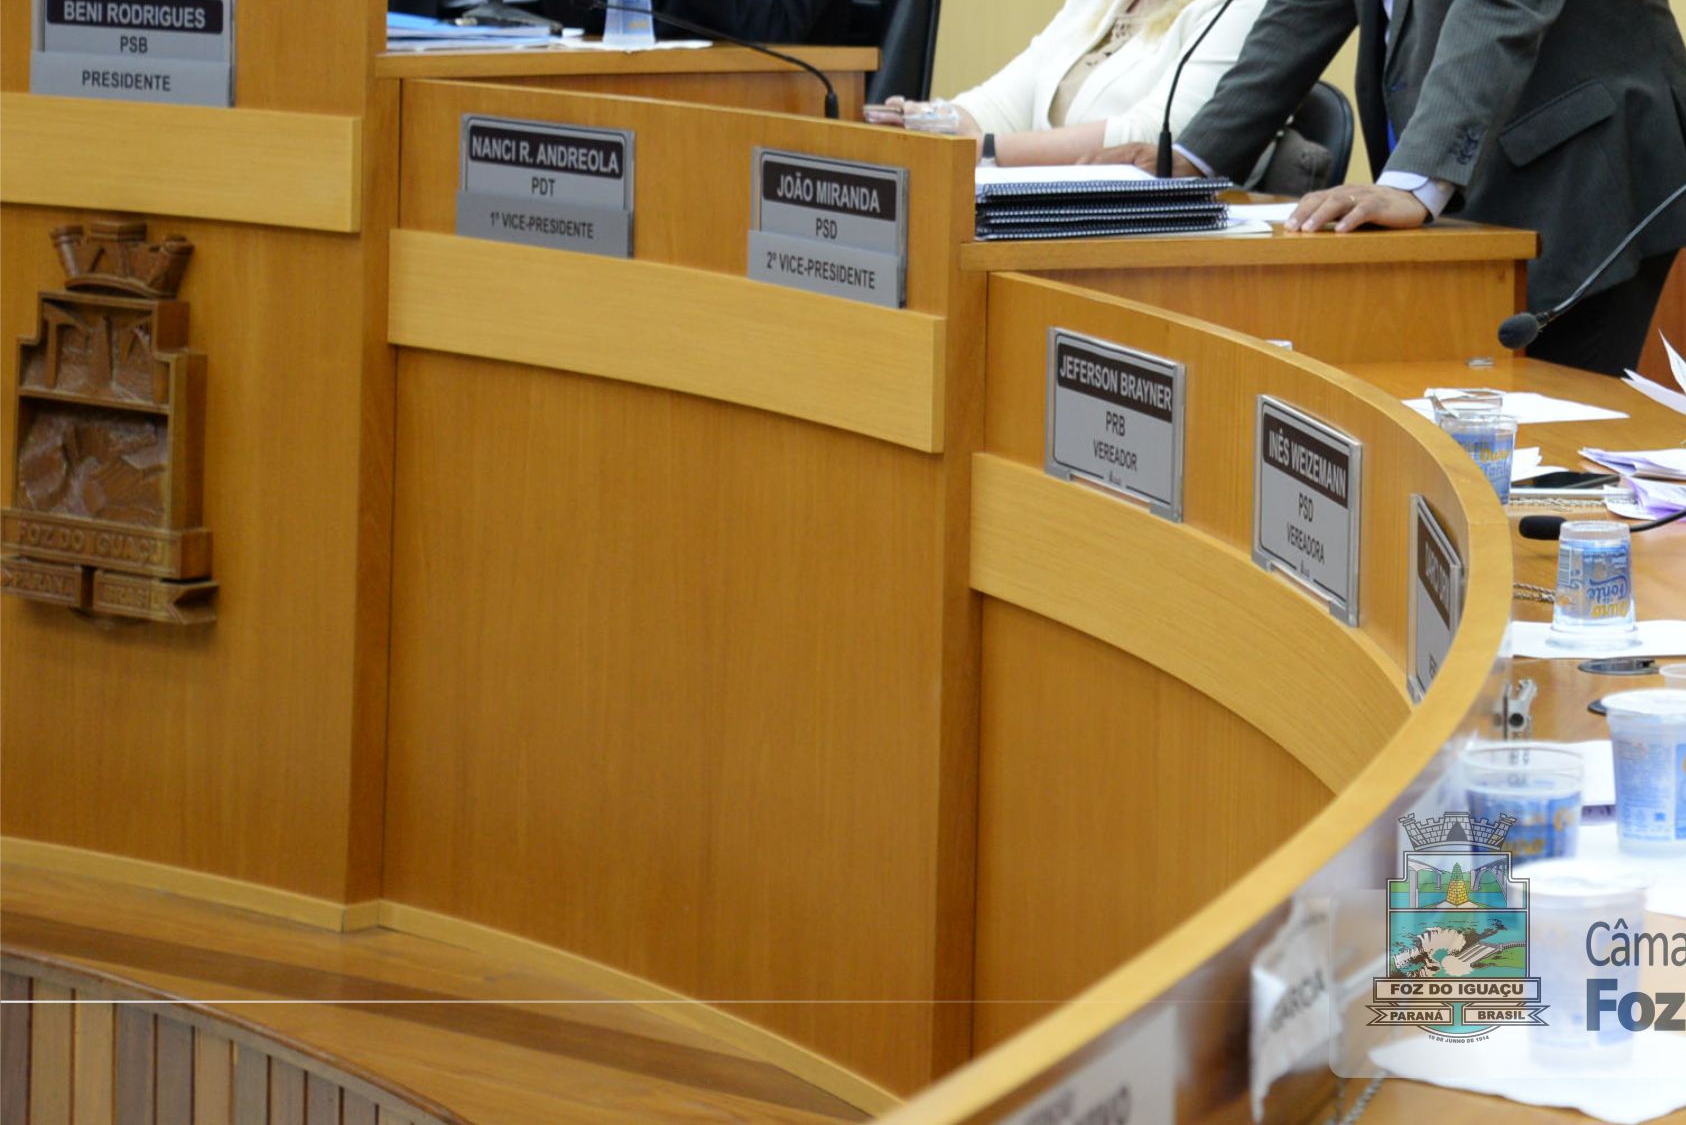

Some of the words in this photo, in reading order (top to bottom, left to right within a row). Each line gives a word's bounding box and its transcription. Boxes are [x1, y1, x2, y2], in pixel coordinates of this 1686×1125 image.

[63, 0, 103, 21] BENI
[106, 1, 206, 28] RODRIGUES
[119, 35, 149, 54] PSB
[81, 69, 172, 92] PRESIDENTE
[472, 136, 517, 161] NANCI
[519, 140, 535, 164] R.
[536, 143, 620, 173] ANDREOLA
[530, 177, 556, 197] PDT
[776, 172, 815, 200] JOÃO
[816, 180, 881, 213] MIRANDA
[502, 212, 595, 239] VICE-PRESIDENTE
[814, 217, 839, 240] PSD
[779, 252, 876, 290] VICE-PRESIDENTE
[1059, 354, 1119, 393] JEFERSON
[1120, 372, 1173, 411] BRAYNER
[1104, 411, 1127, 437] PRB
[1093, 438, 1137, 472] VEREADOR
[1291, 441, 1347, 499] WEIZEMANN
[1297, 492, 1315, 524] PSD
[1286, 522, 1325, 564] VEREADORA
